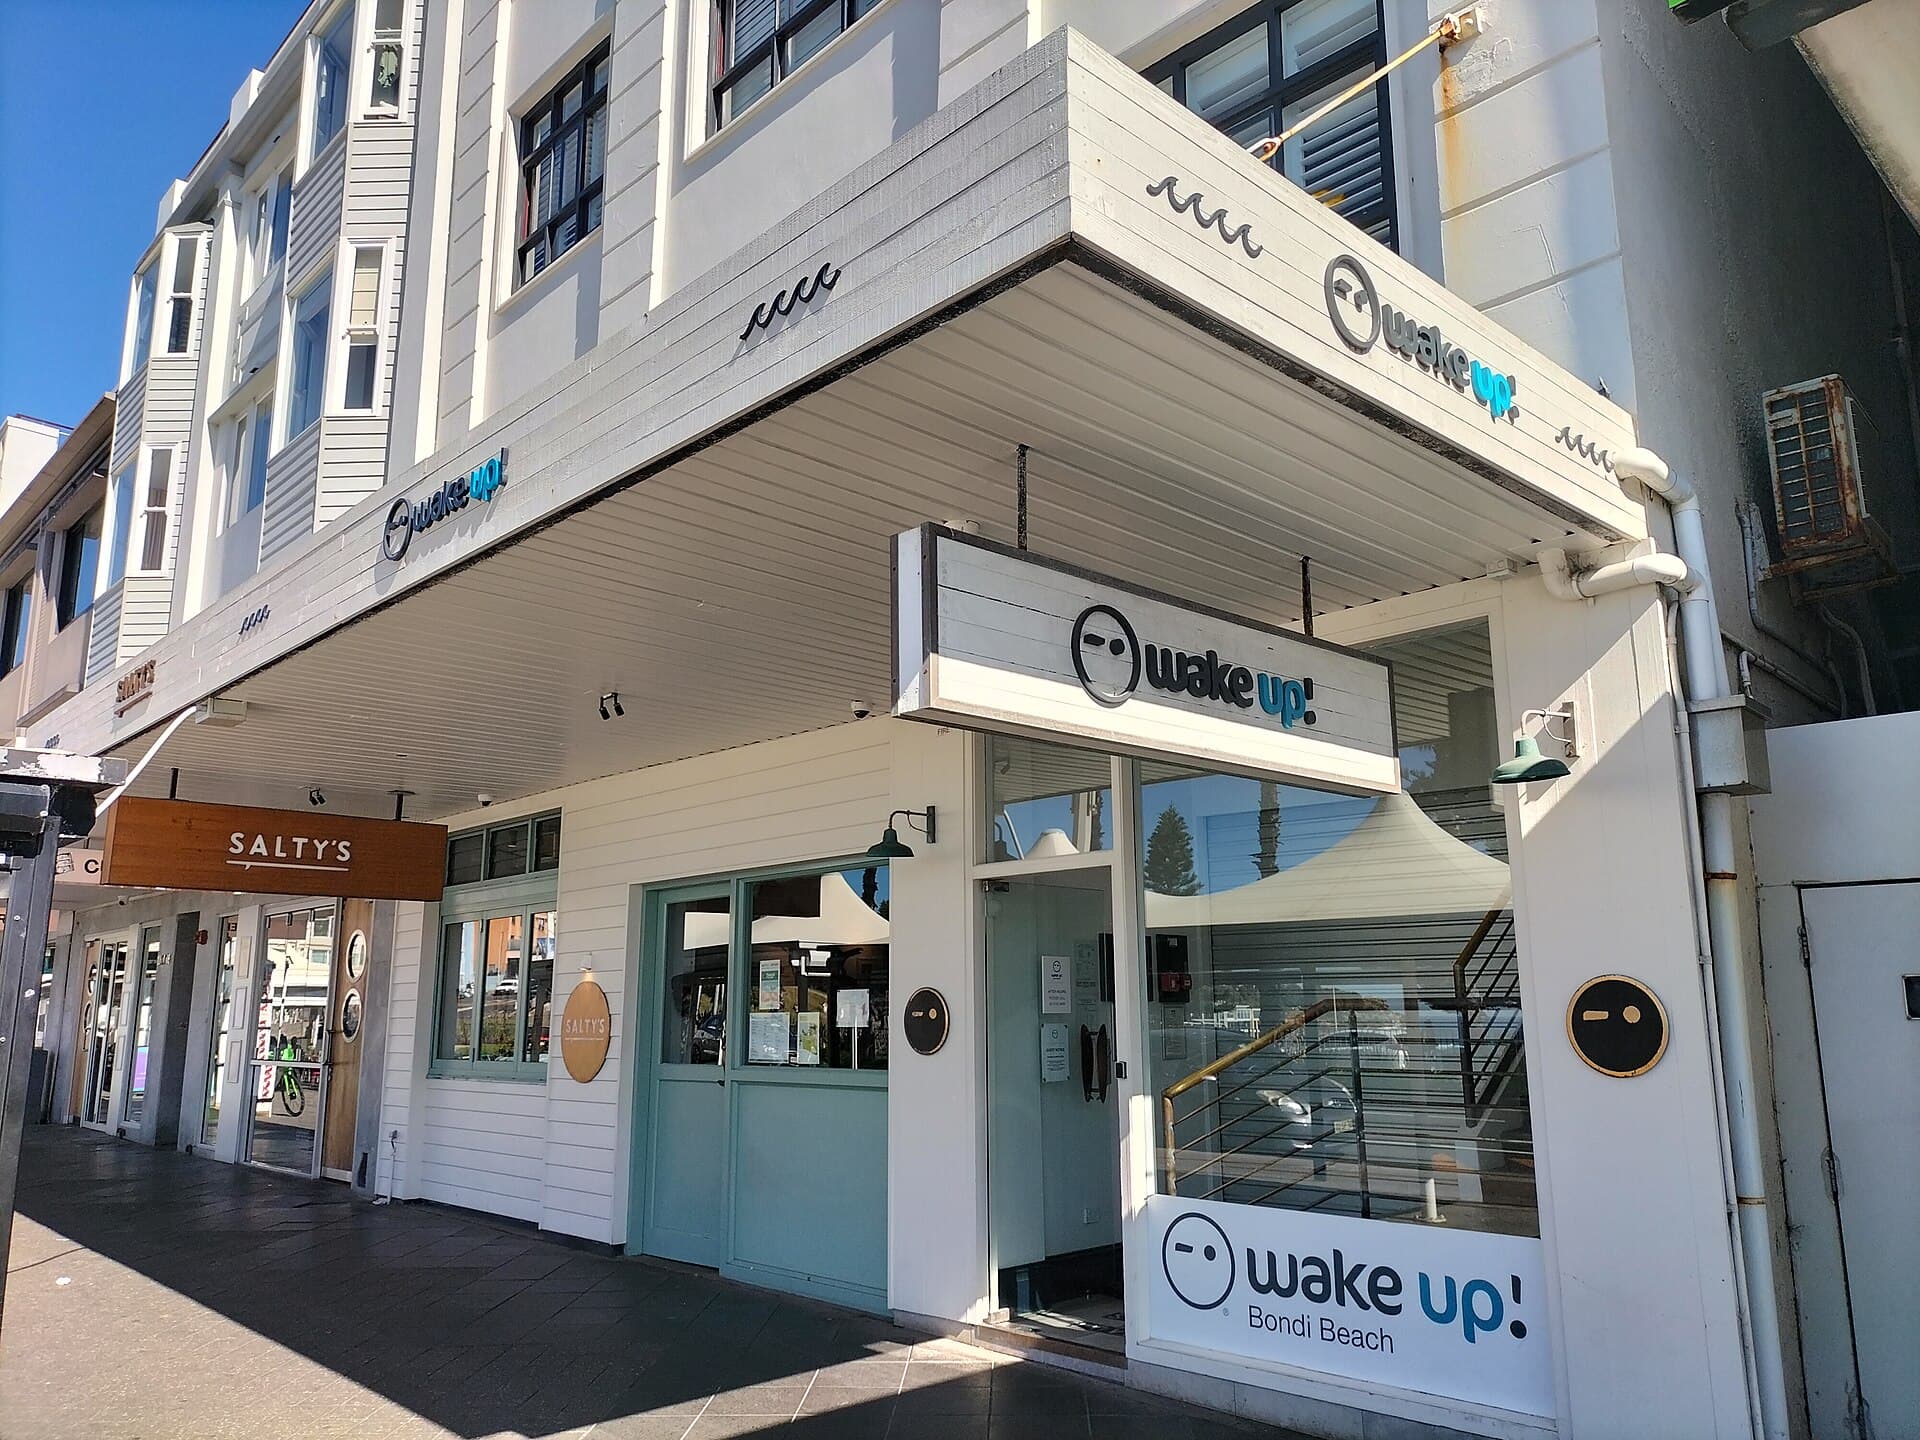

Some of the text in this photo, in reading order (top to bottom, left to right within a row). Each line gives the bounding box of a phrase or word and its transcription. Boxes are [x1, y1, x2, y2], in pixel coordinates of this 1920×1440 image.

[1382, 304, 1519, 418] wake up!
[413, 447, 509, 532] wake up!
[1145, 643, 1317, 729] wake up!
[228, 832, 352, 862] SALTY'S
[565, 1019, 605, 1034] SALTY'S
[1246, 1247, 1528, 1344] wake up!
[1248, 1304, 1394, 1354] Bondi Beach
